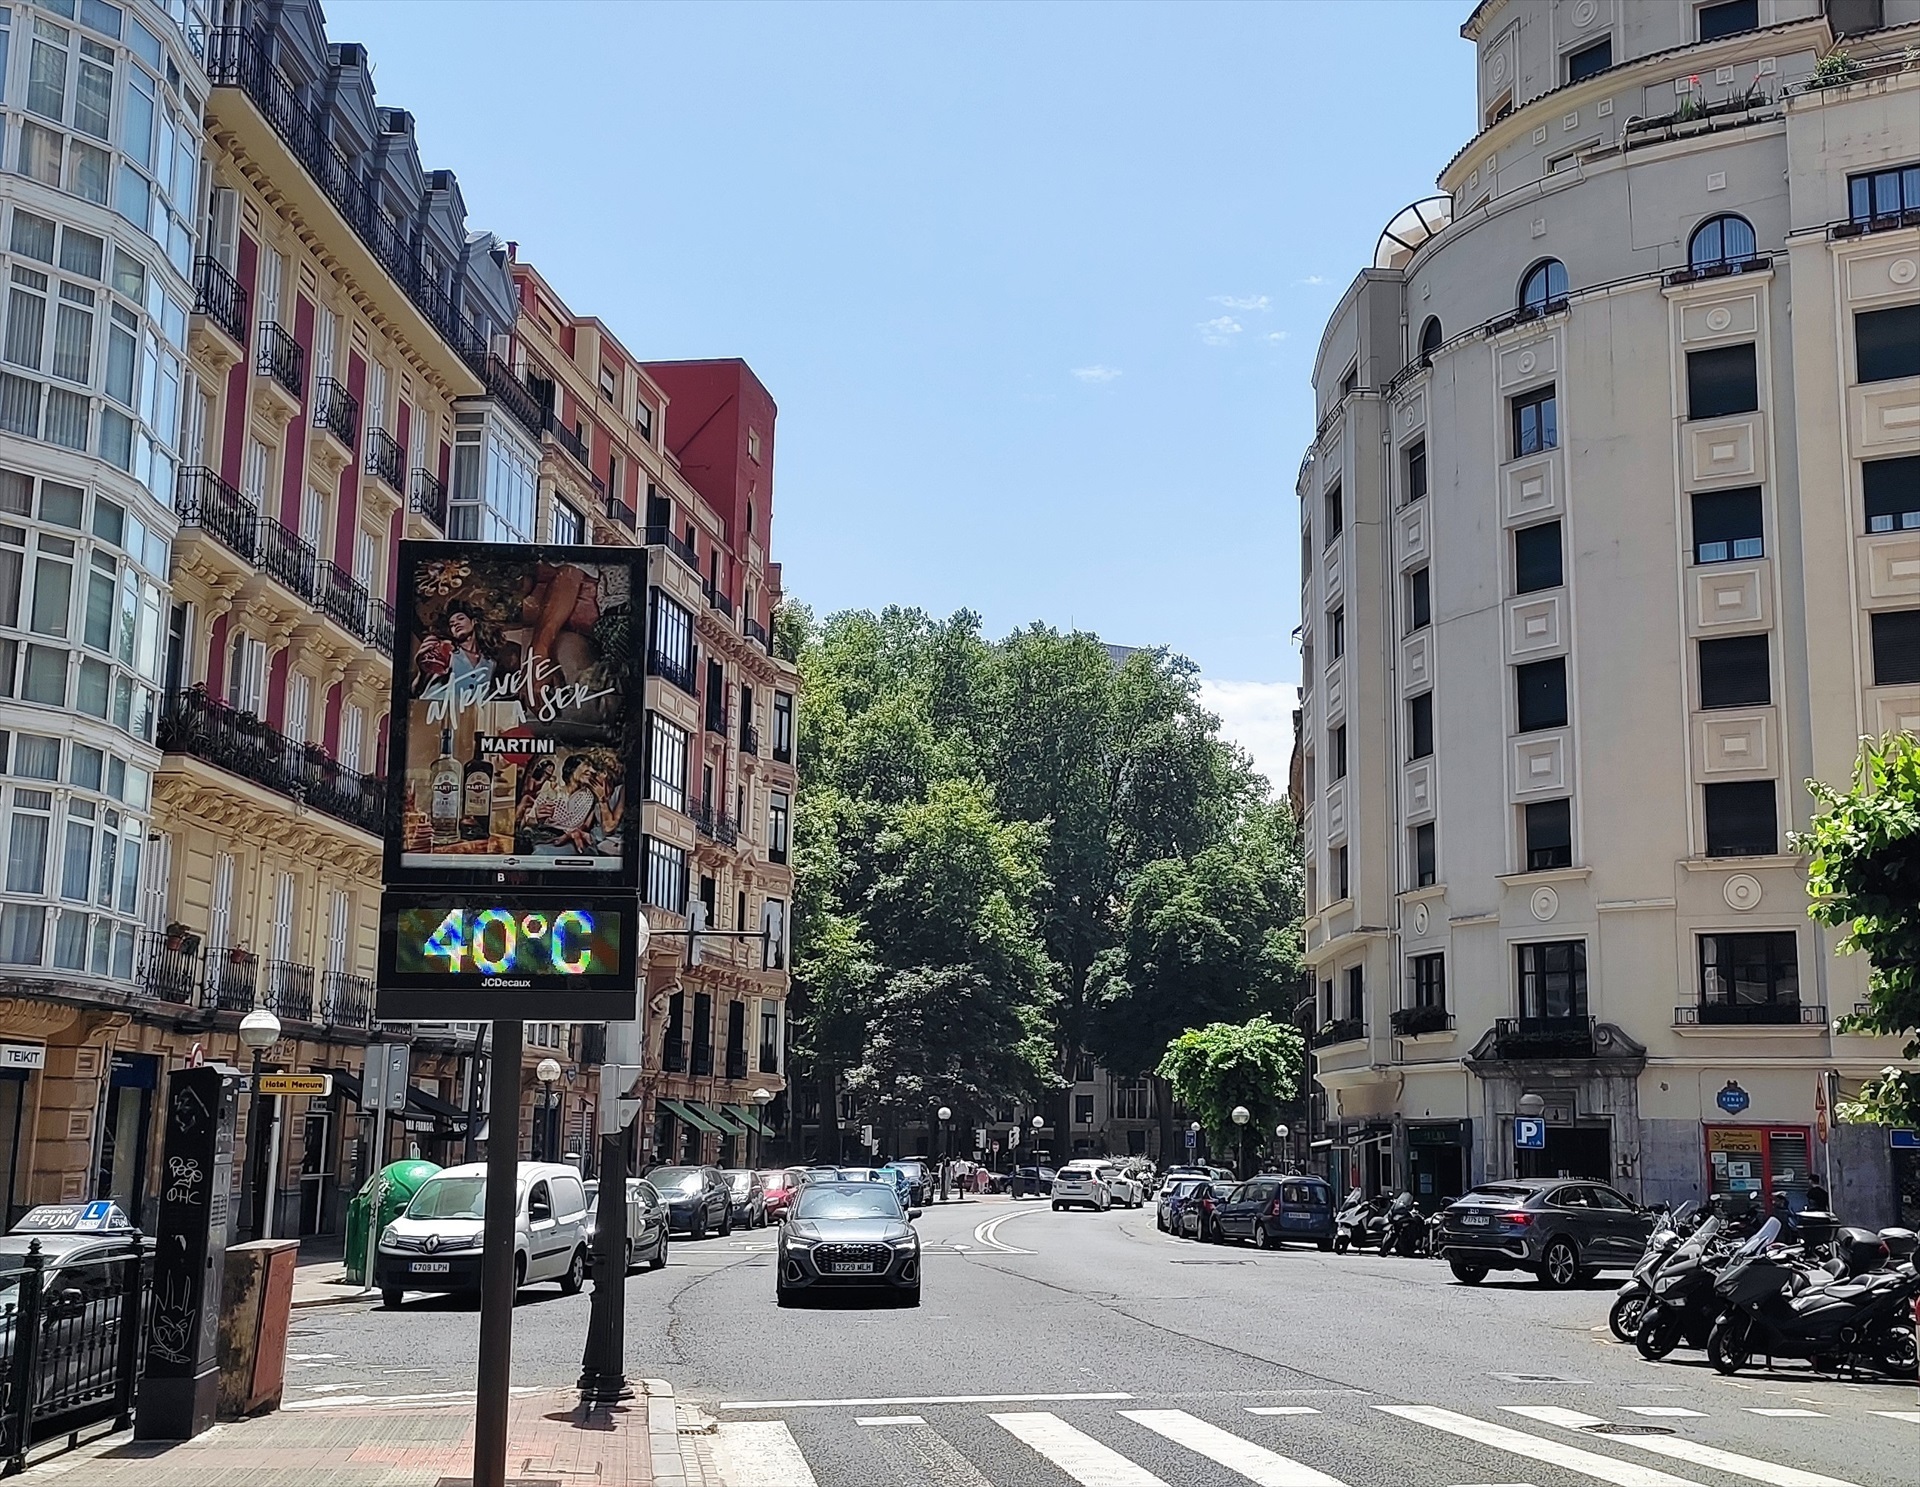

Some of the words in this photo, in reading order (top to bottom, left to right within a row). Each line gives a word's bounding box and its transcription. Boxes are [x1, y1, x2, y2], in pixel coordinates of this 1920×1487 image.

[539, 682, 616, 722] SER
[481, 738, 554, 753] MARTINI
[497, 872, 506, 882] B
[424, 908, 594, 975] 40°C
[481, 977, 532, 988] JCDecaux
[265, 1080, 288, 1089] Hotel
[291, 1080, 323, 1090] Mercure
[1517, 1121, 1538, 1144] P
[86, 1203, 100, 1218] L
